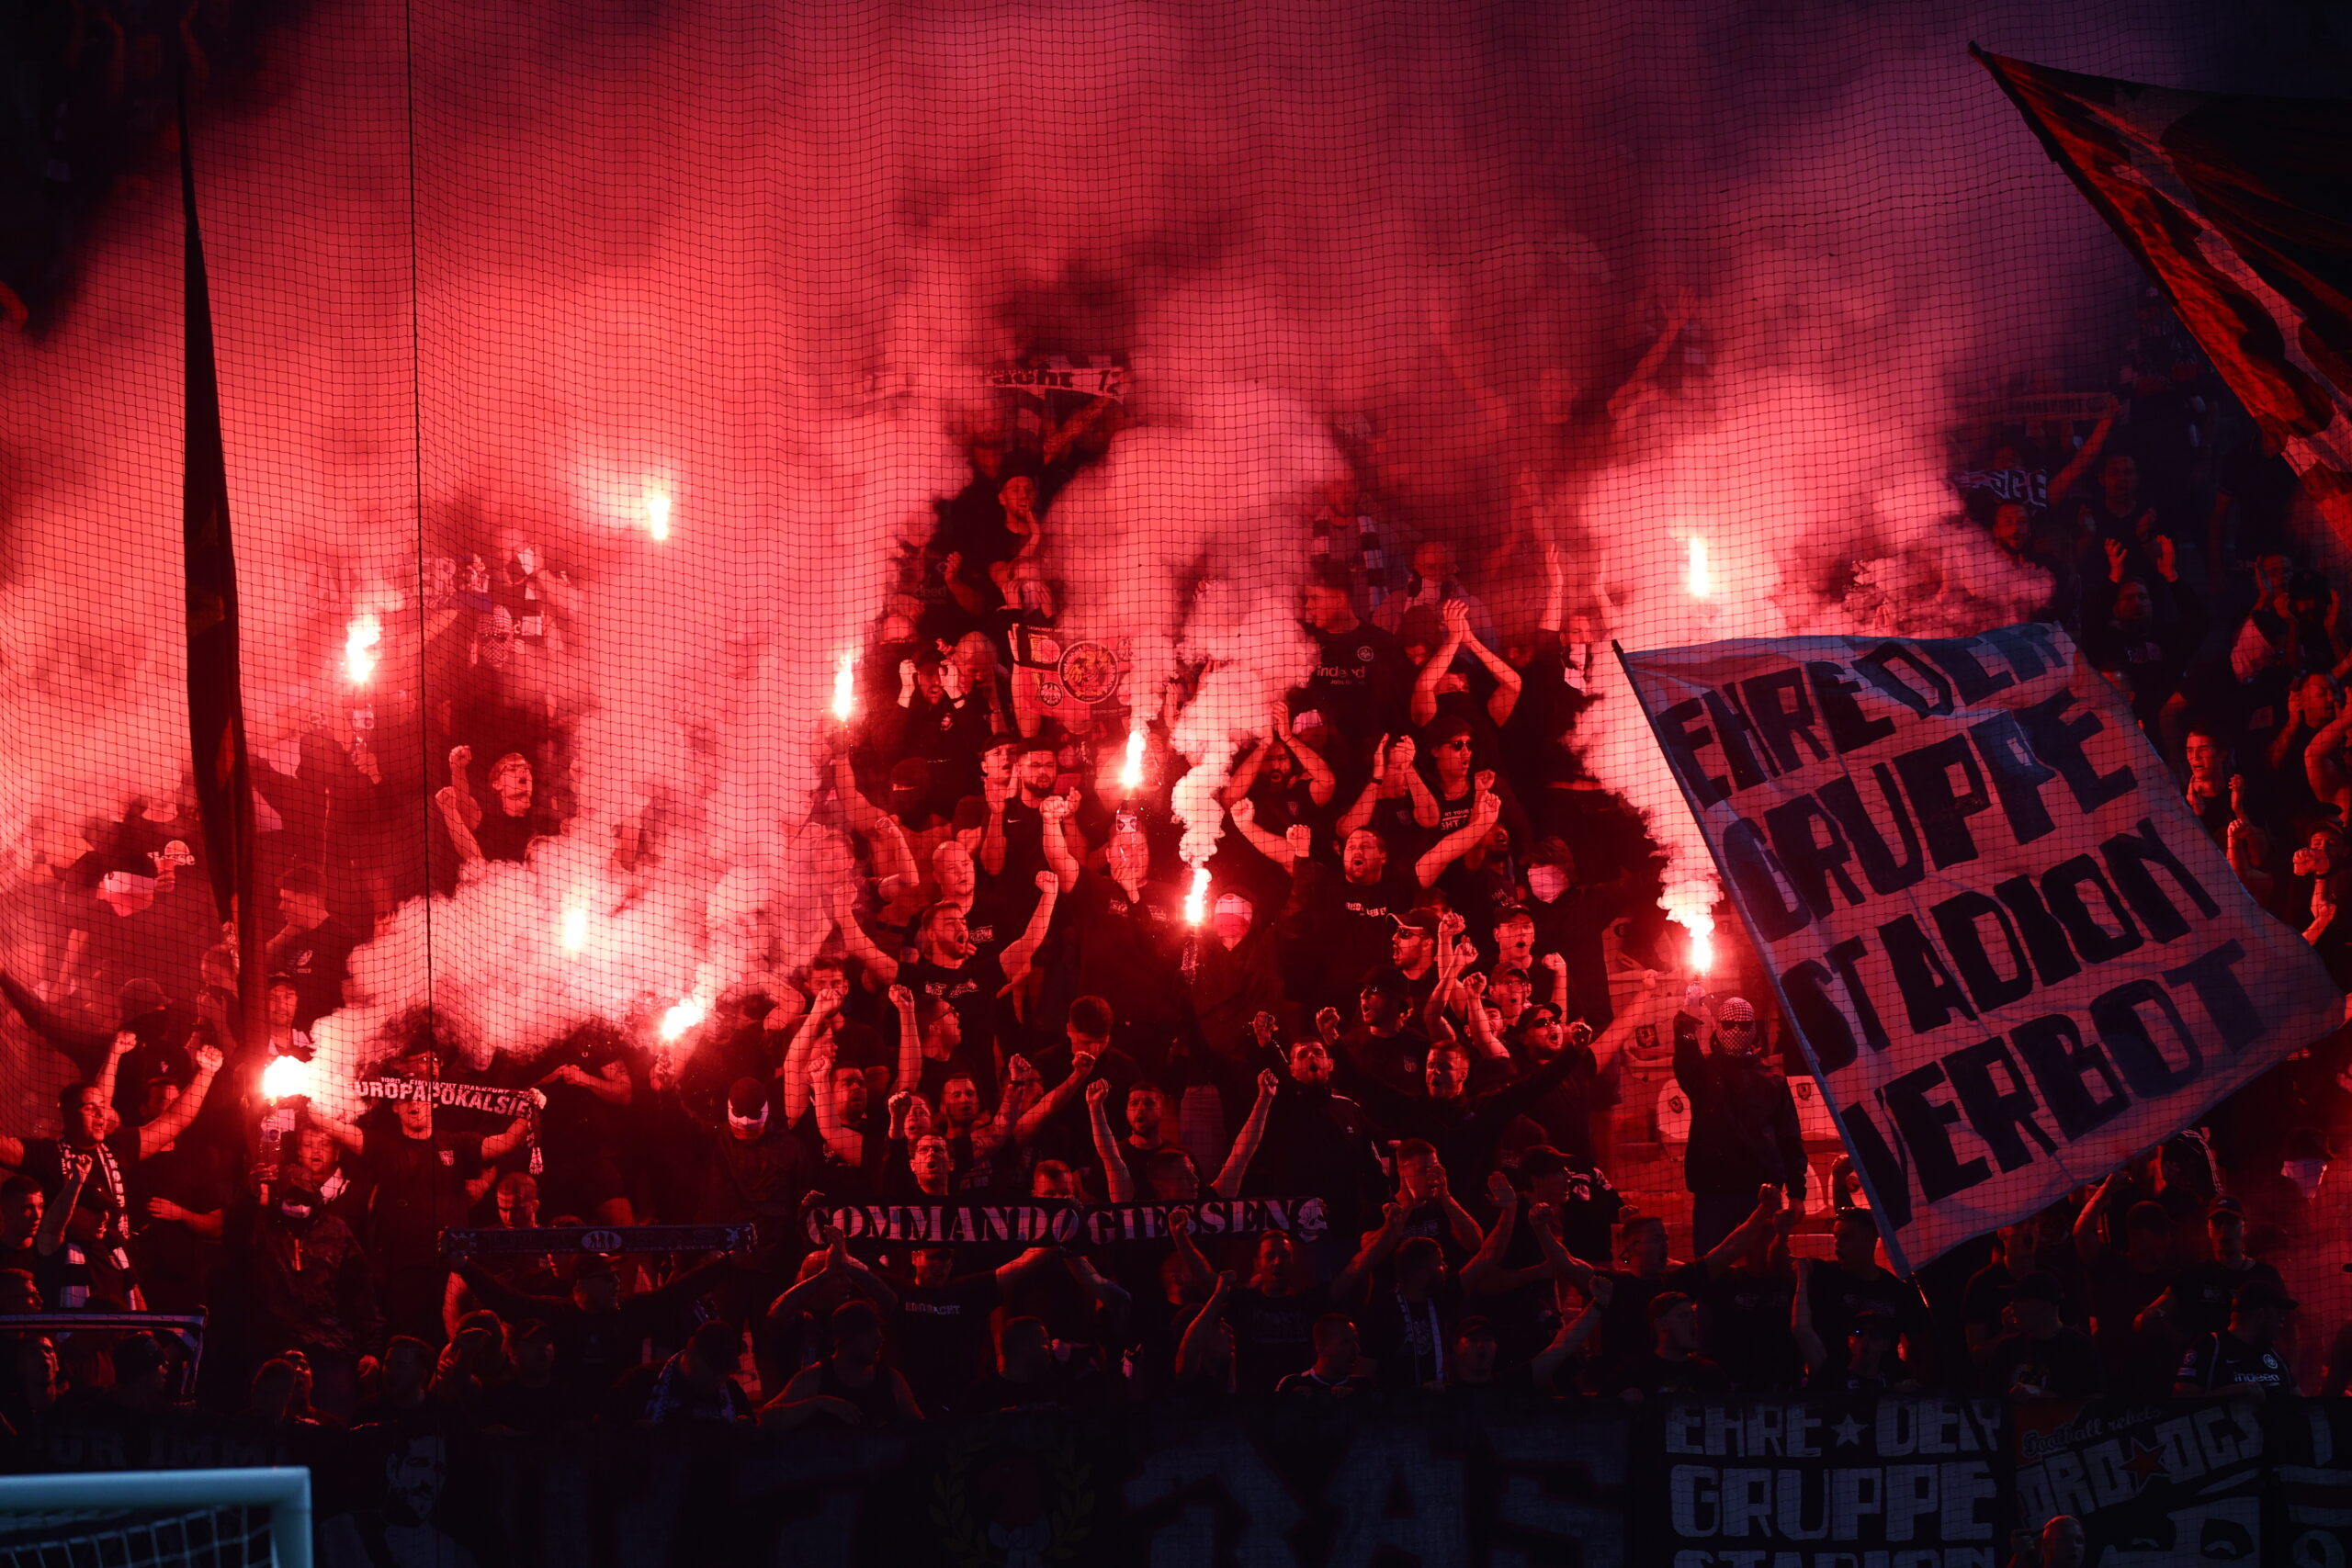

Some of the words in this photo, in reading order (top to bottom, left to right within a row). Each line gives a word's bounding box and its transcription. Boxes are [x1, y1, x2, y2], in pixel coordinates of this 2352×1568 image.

[1656, 660, 1895, 809] EHRE
[1723, 688, 2138, 942] GRUPPE
[1781, 818, 2222, 1076] STADION
[1837, 939, 2267, 1231] VERBOT
[807, 1206, 1079, 1245] COMMANDO
[1666, 1399, 1822, 1458] EHRE
[2233, 1371, 2280, 1382] indeed
[1670, 1461, 1997, 1541] GRUPPE
